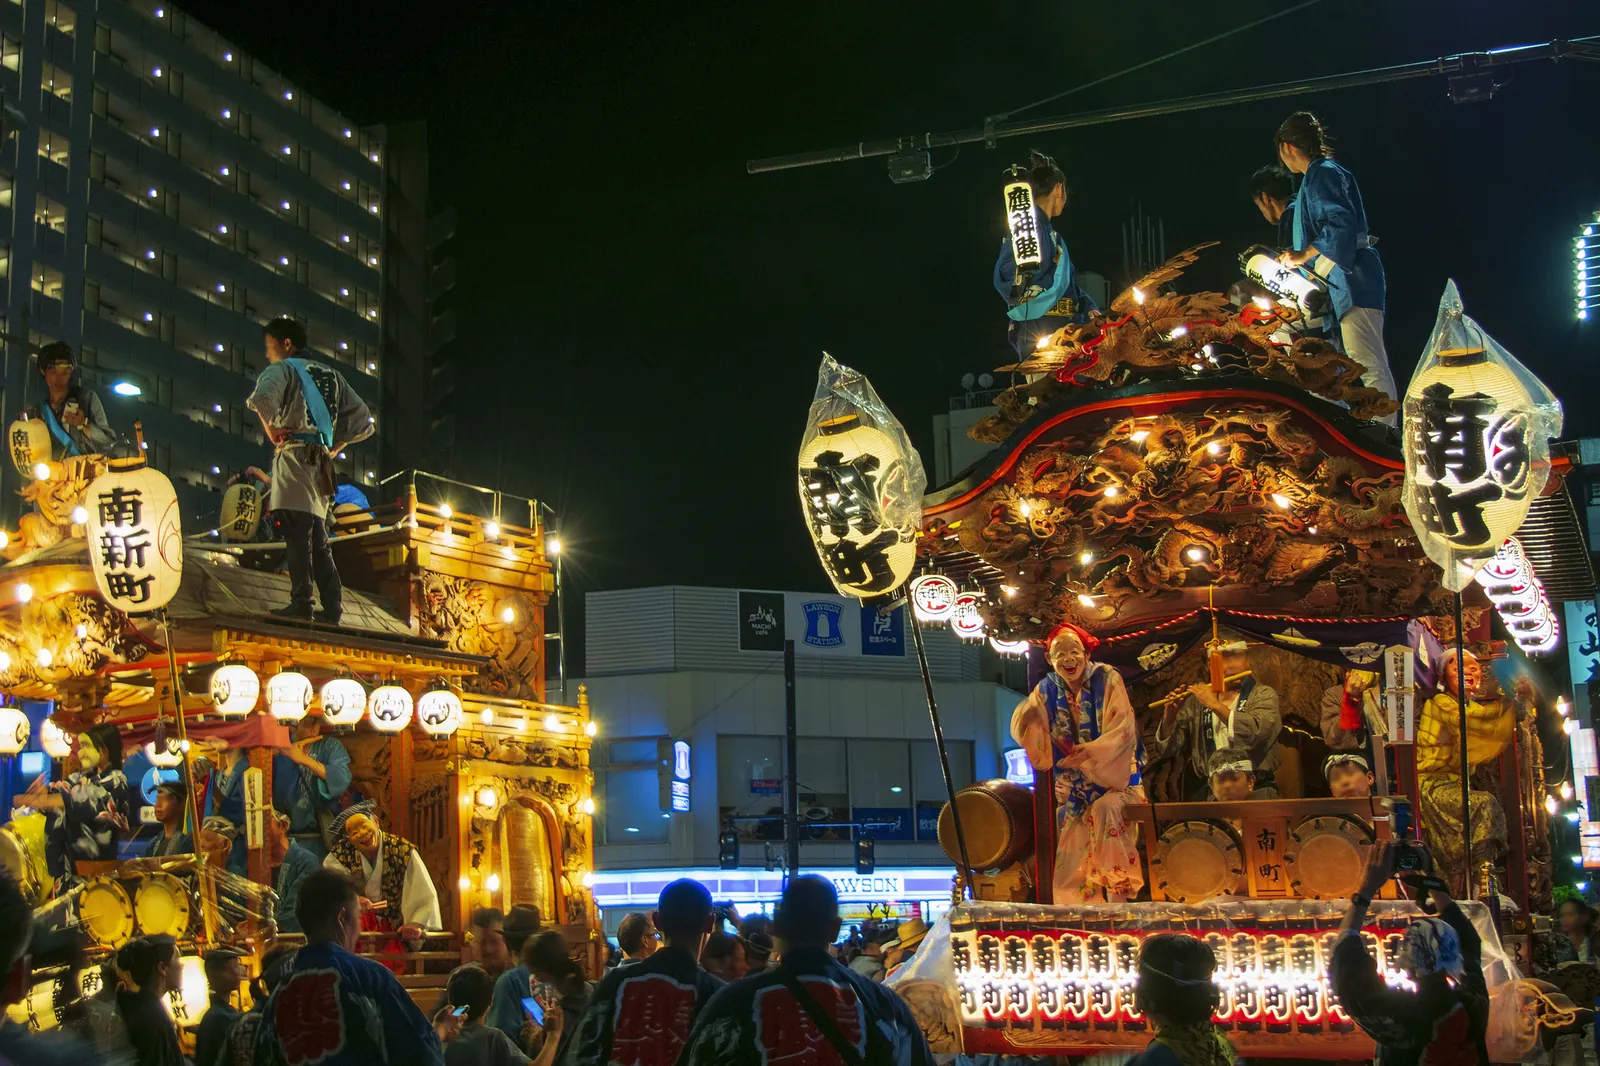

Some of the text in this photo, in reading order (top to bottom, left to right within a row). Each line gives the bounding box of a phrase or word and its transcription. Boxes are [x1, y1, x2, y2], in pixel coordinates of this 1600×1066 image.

[1404, 381, 1502, 548] 南町
[98, 486, 156, 604] 南新町
[799, 450, 900, 595] 南町
[805, 604, 841, 614] LAWSON
[806, 635, 841, 645] STATION
[1256, 828, 1281, 882] 南町
[833, 877, 899, 893] AWSON
